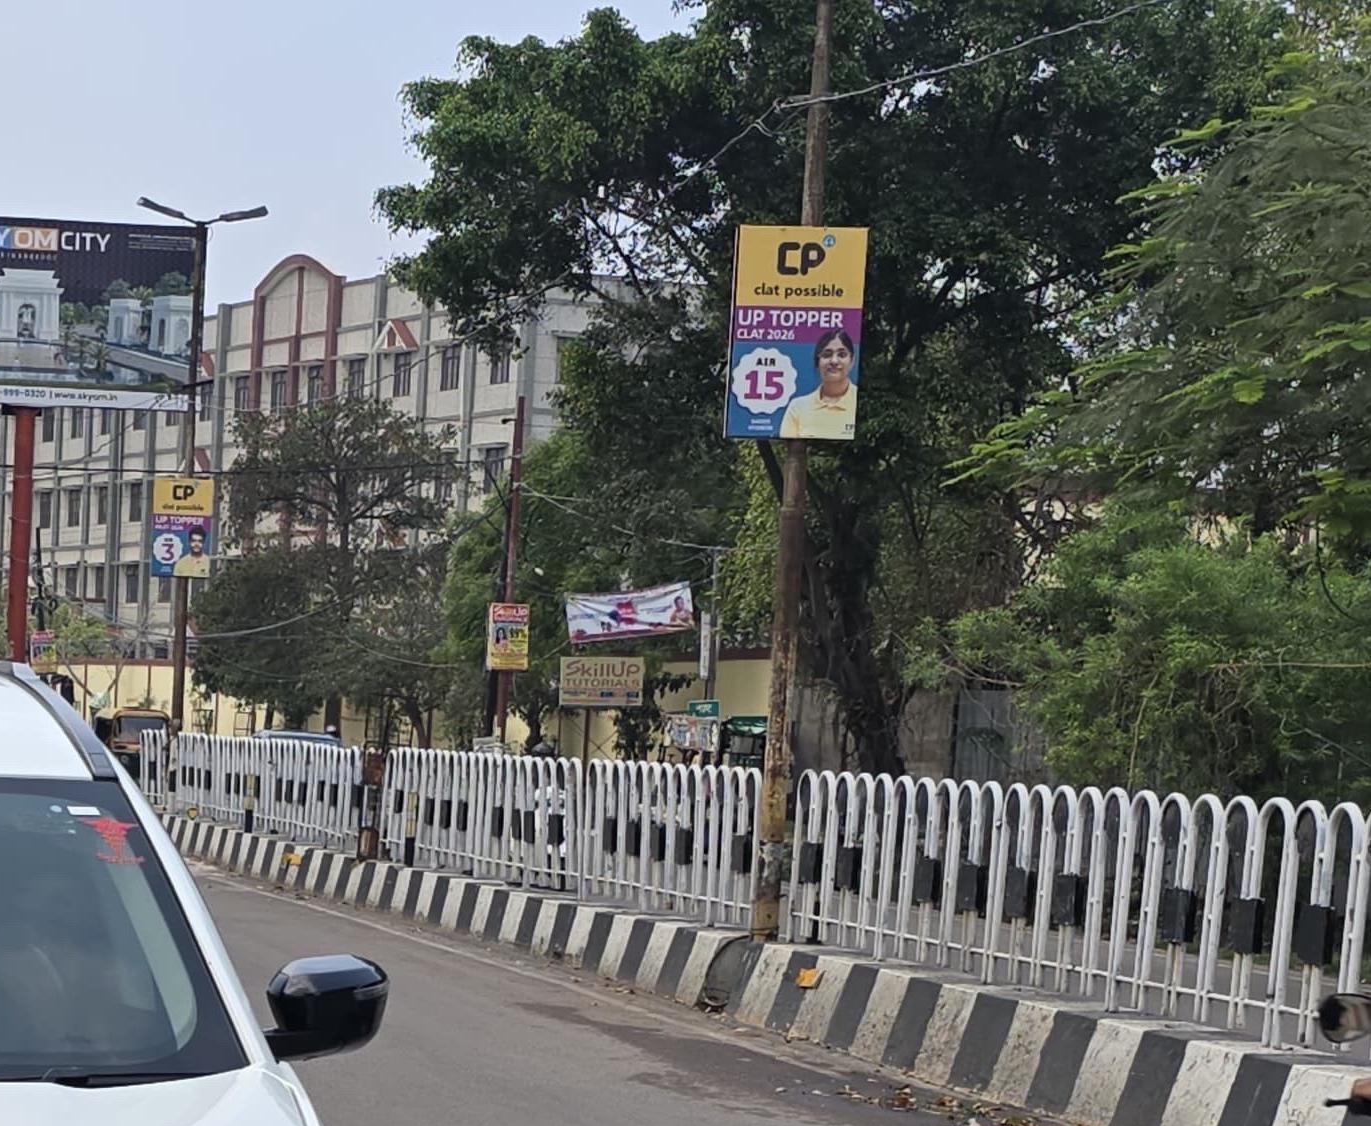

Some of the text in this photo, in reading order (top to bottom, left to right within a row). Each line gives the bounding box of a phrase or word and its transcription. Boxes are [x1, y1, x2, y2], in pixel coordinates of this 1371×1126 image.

[777, 241, 825, 275] CP
[754, 282, 844, 300] clat possible
[738, 309, 843, 328] UP TOPPER
[736, 328, 795, 340] CLAT 2026
[756, 357, 776, 366] AIR
[744, 370, 784, 401] 15
[173, 485, 195, 501] CP
[161, 543, 174, 561] 3
